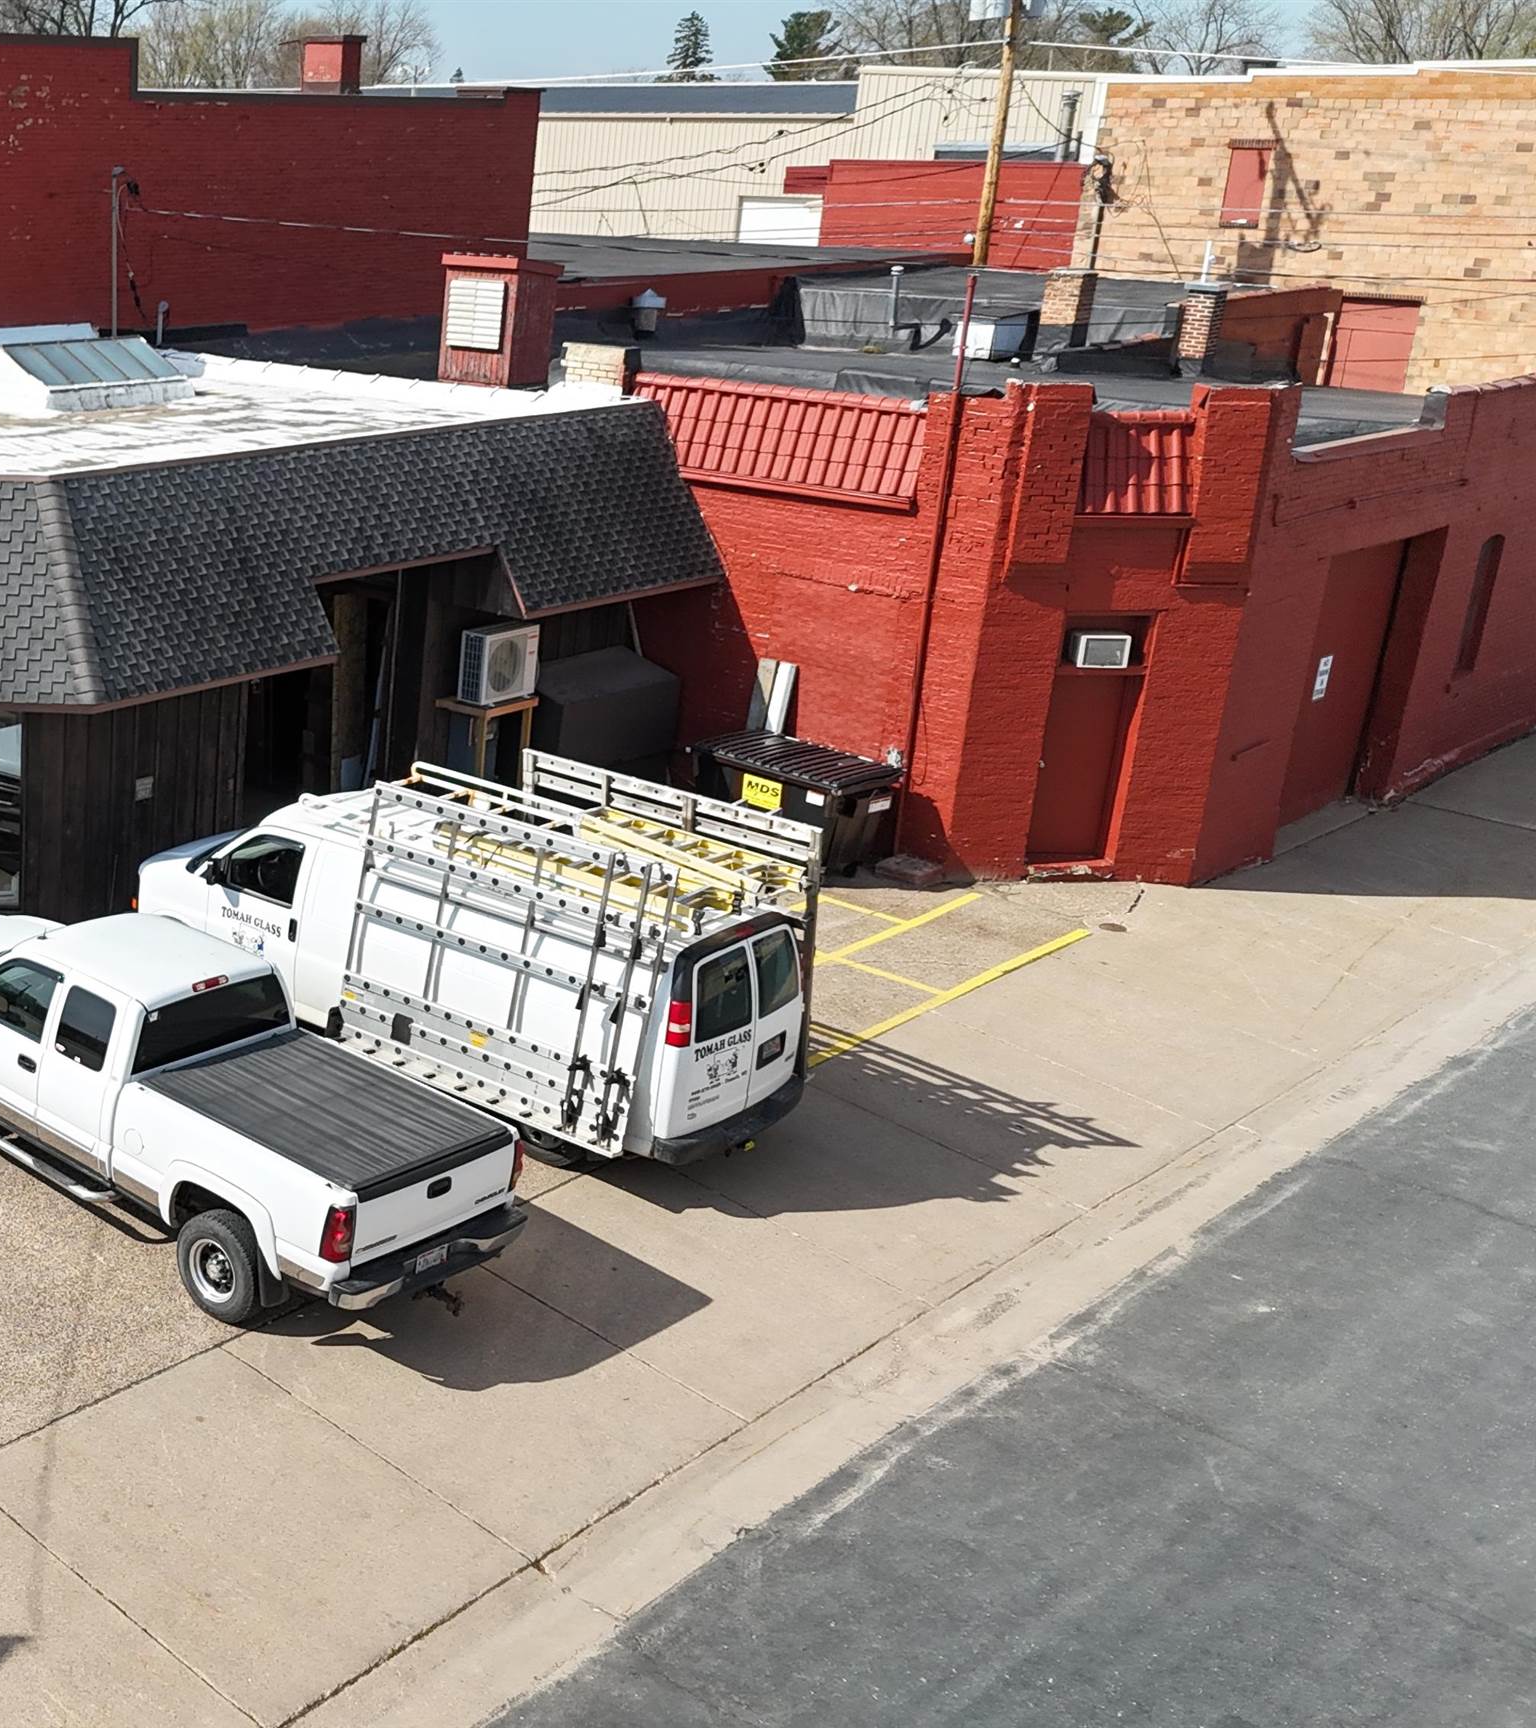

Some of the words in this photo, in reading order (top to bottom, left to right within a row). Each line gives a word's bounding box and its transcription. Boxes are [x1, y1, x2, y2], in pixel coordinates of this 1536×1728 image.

[746, 780, 780, 797] MDS
[221, 906, 252, 924] TOMAH
[253, 917, 282, 938] GLASS
[694, 1039, 726, 1063] TOMAH
[727, 1029, 753, 1048] GLASS
